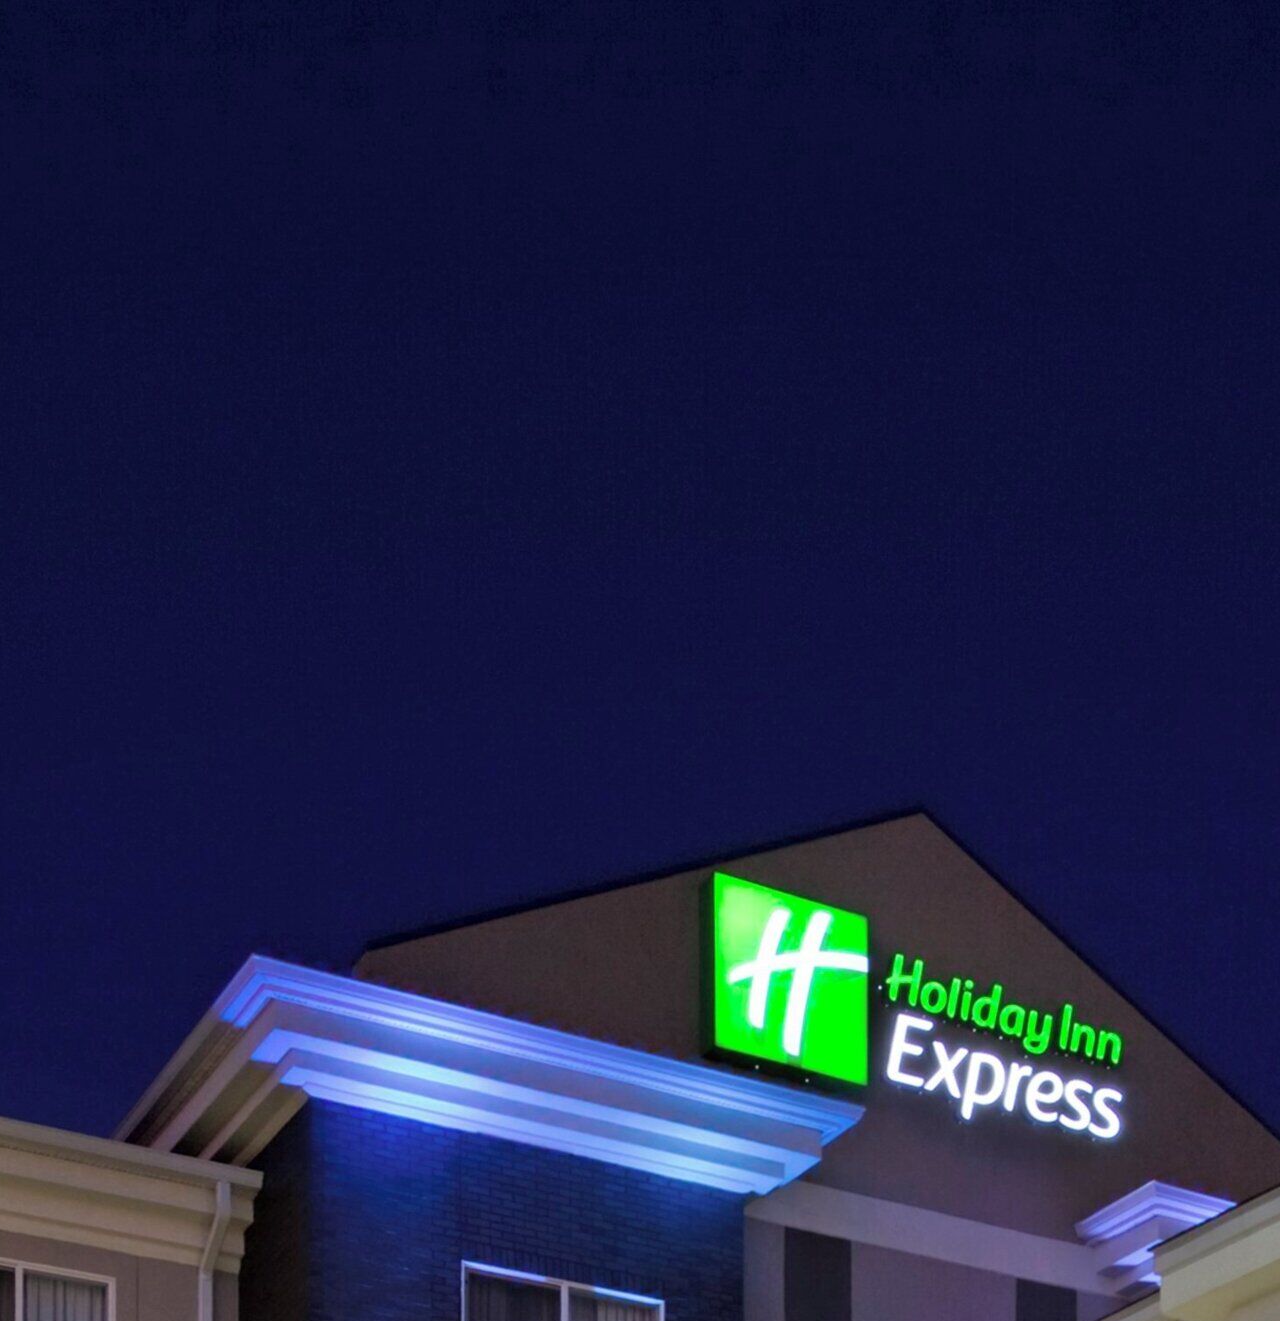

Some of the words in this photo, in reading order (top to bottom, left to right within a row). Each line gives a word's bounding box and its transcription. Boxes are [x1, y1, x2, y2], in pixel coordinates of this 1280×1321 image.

[728, 909, 869, 1056] H
[886, 953, 1054, 1055] Holiday
[1059, 1004, 1122, 1064] Inn
[886, 1013, 1123, 1139] Express
